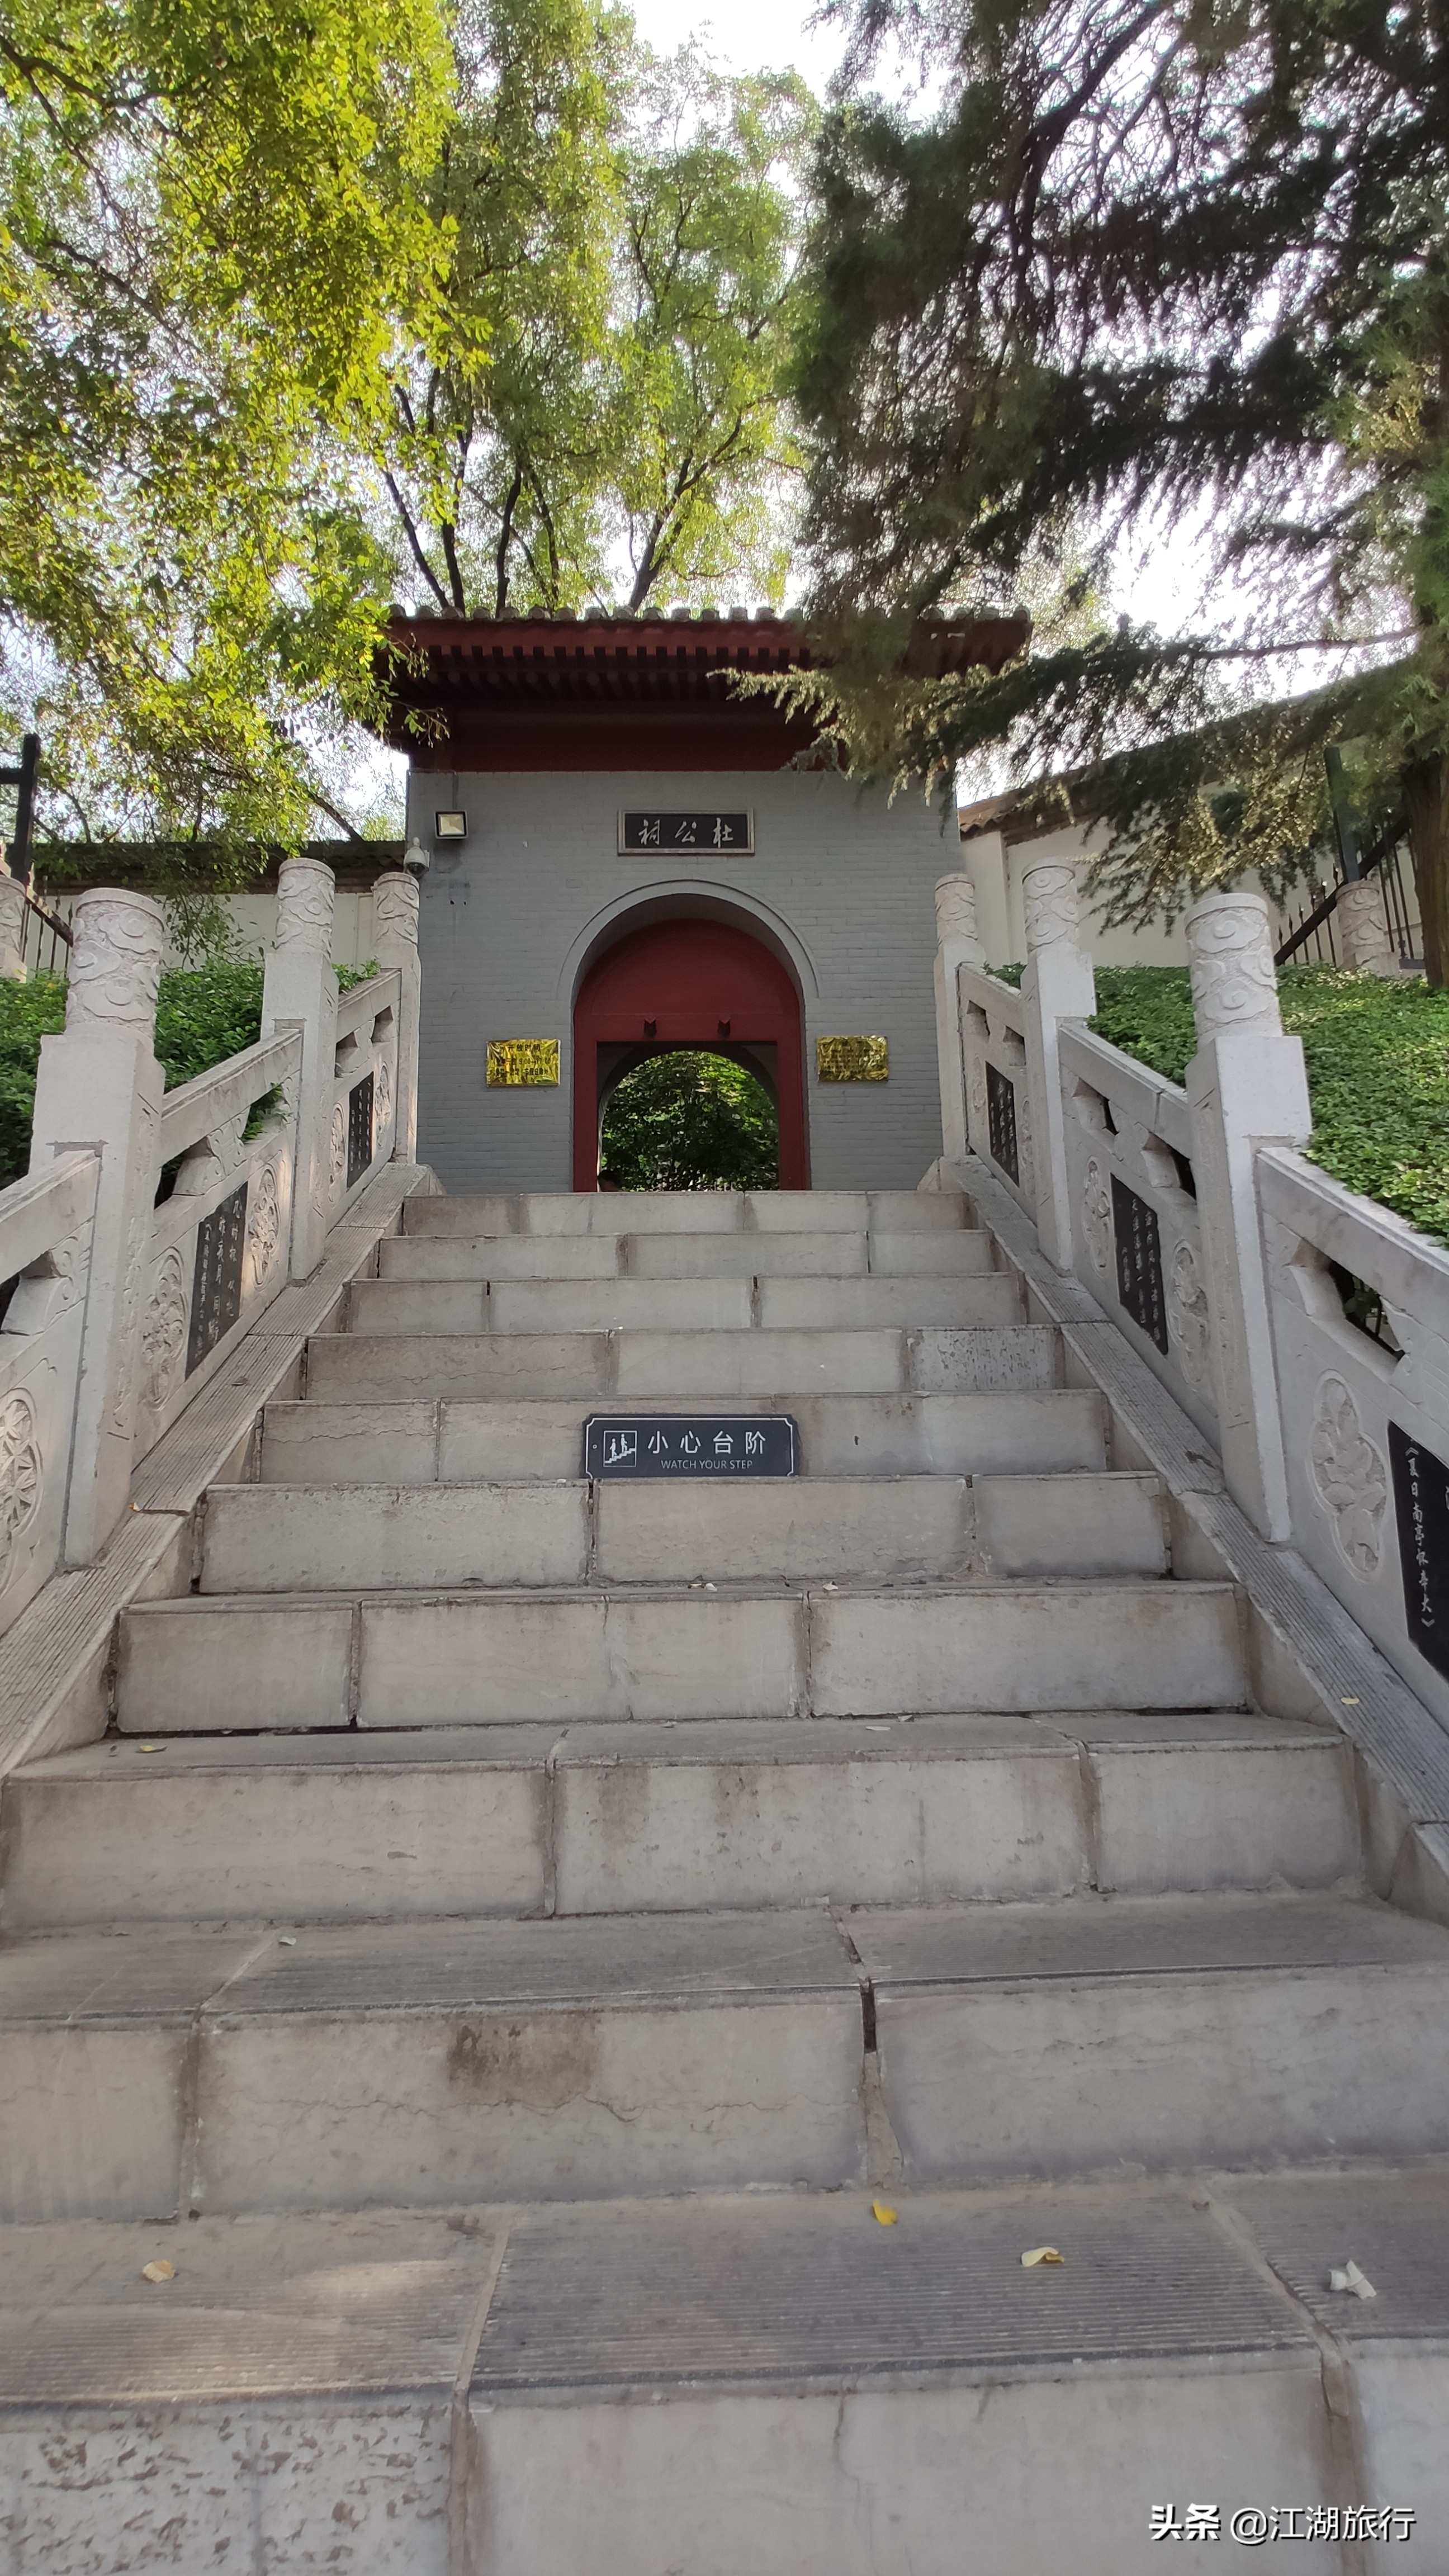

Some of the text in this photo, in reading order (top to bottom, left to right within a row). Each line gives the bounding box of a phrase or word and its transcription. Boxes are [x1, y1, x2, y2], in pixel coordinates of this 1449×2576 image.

[508, 1044, 541, 1052] 开放时间
[647, 1430, 766, 1455] 小心台阶
[661, 1460, 753, 1469] WATCH YOUR STEP
